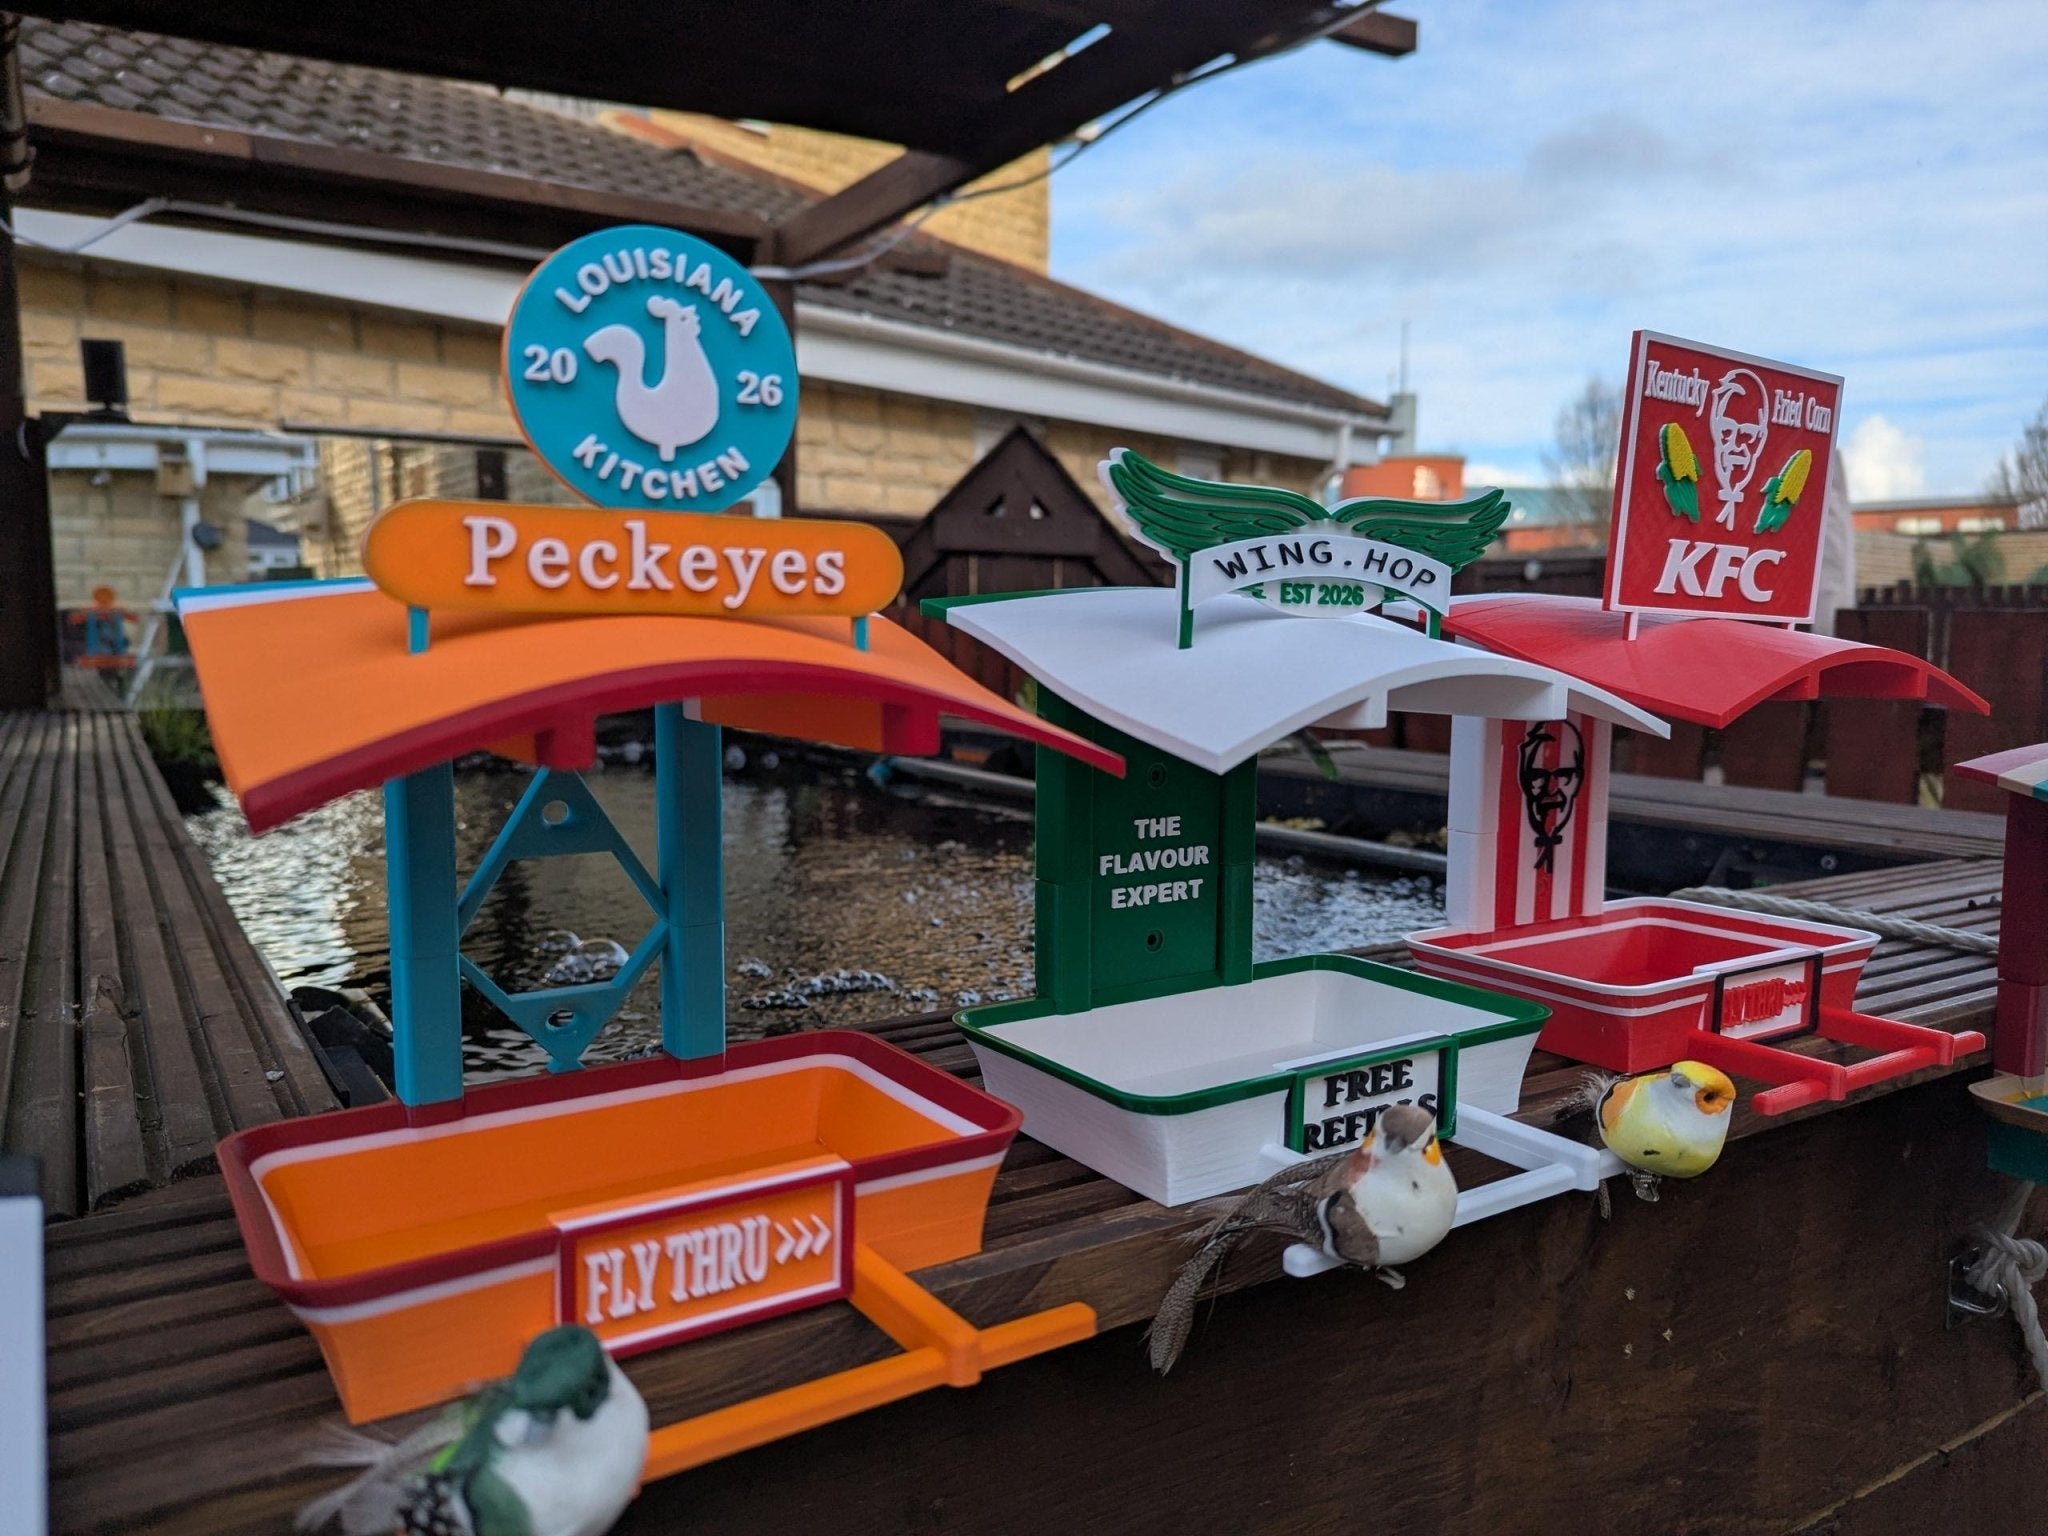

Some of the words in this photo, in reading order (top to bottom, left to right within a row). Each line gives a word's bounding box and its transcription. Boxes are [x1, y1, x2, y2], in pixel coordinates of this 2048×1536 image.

[555, 247, 761, 337] LOUISIANA
[523, 344, 577, 384] 20
[736, 370, 783, 406] 26
[1645, 360, 1710, 417] Kentucky
[1772, 389, 1804, 428] Fried
[1805, 396, 1832, 434] Corn
[572, 433, 750, 500] KITCHEN
[463, 516, 846, 609] Peckeyes
[1653, 538, 1787, 603] KFC
[1280, 583, 1312, 606] EST
[1317, 585, 1364, 607] 2026
[1134, 815, 1181, 840] THE
[1099, 845, 1209, 876] FLAVOUR
[1111, 878, 1204, 909] EXPERT
[1323, 1058, 1414, 1108] FREE
[1303, 1093, 1437, 1154] REFIS
[584, 1239, 661, 1324] FLY
[665, 1214, 770, 1303] THRU
